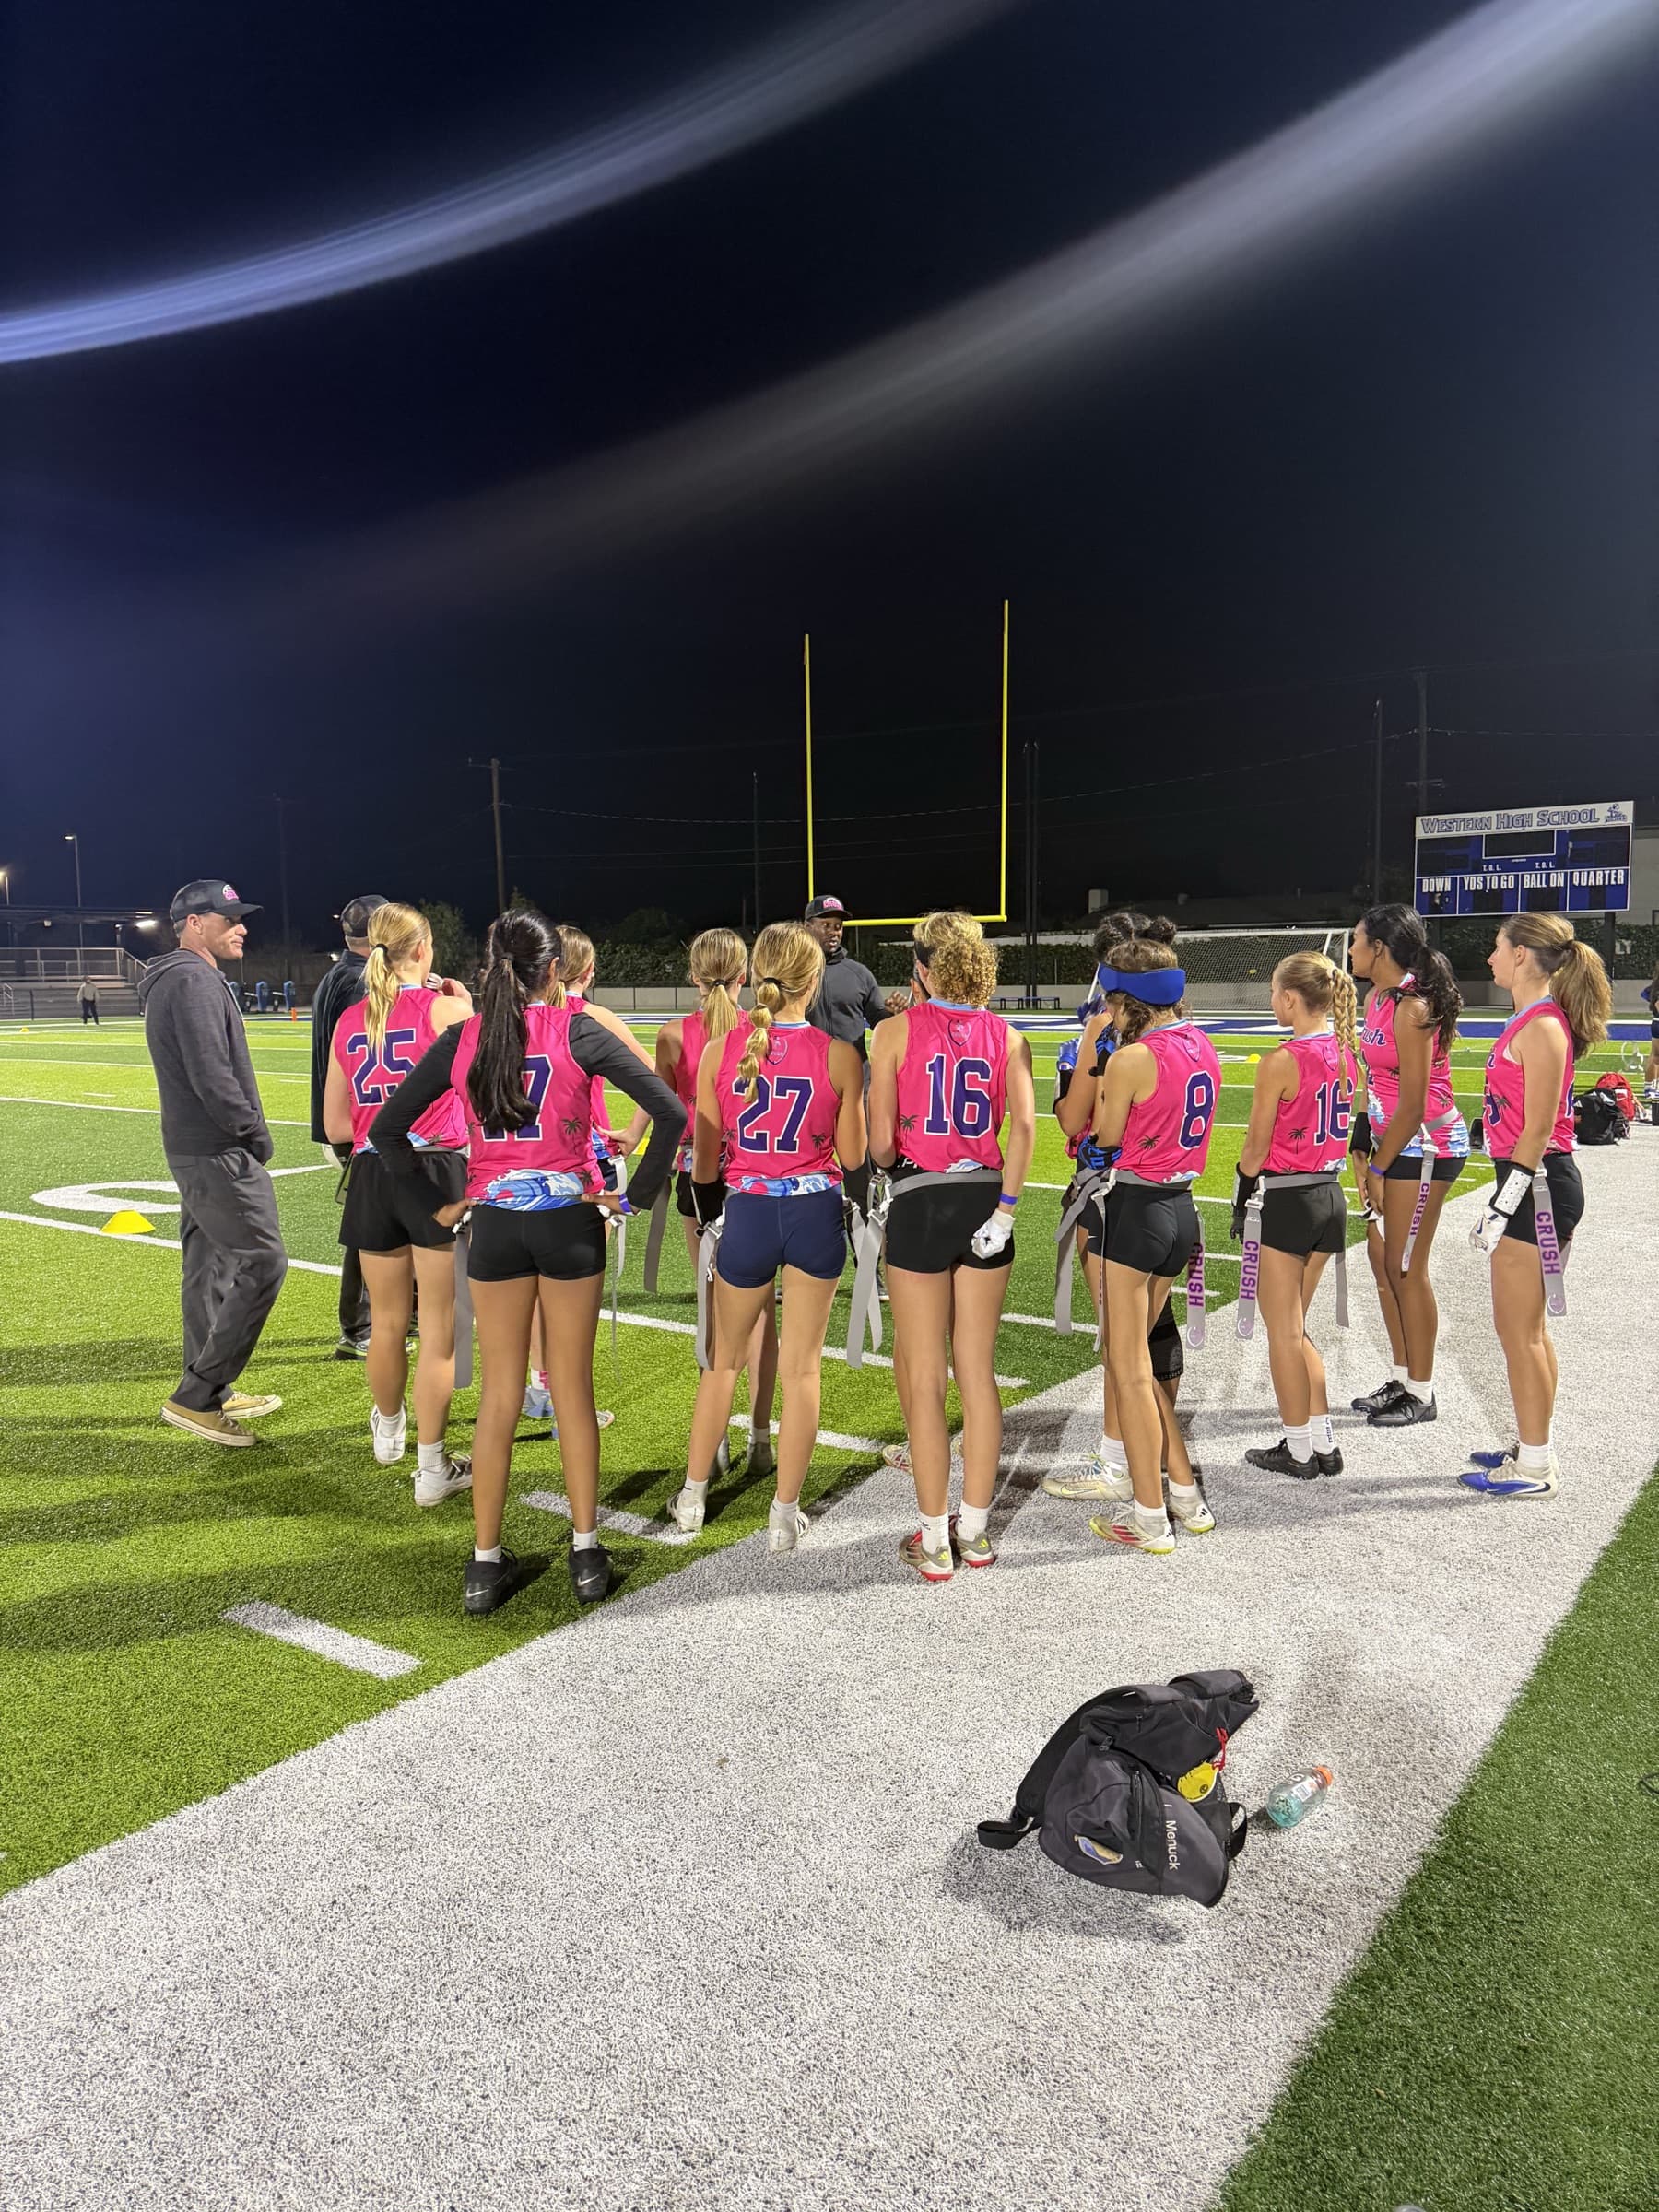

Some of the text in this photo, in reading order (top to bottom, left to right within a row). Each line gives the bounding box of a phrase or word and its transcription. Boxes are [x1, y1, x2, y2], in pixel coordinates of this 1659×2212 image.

[1421, 817, 1492, 833] WESTERN
[1496, 813, 1533, 829] HIGH
[1537, 809, 1600, 826] SCHOOL
[1422, 877, 1451, 892] DOWN
[1464, 875, 1514, 890] YDS TO GO
[1524, 872, 1565, 888] BALL ON
[1572, 869, 1624, 886] QUARTER
[347, 1028, 417, 1106] 25
[924, 1053, 993, 1138] 16
[732, 1074, 814, 1154] 27
[1178, 1070, 1215, 1150] 8
[1313, 1077, 1354, 1147] 16
[1409, 1182, 1430, 1236] CRUSH
[1240, 1240, 1259, 1300] CRUSH
[1535, 1210, 1561, 1274] CRUSH
[1188, 1241, 1205, 1307] CRUSH
[1165, 1820, 1181, 1870] Menuck
